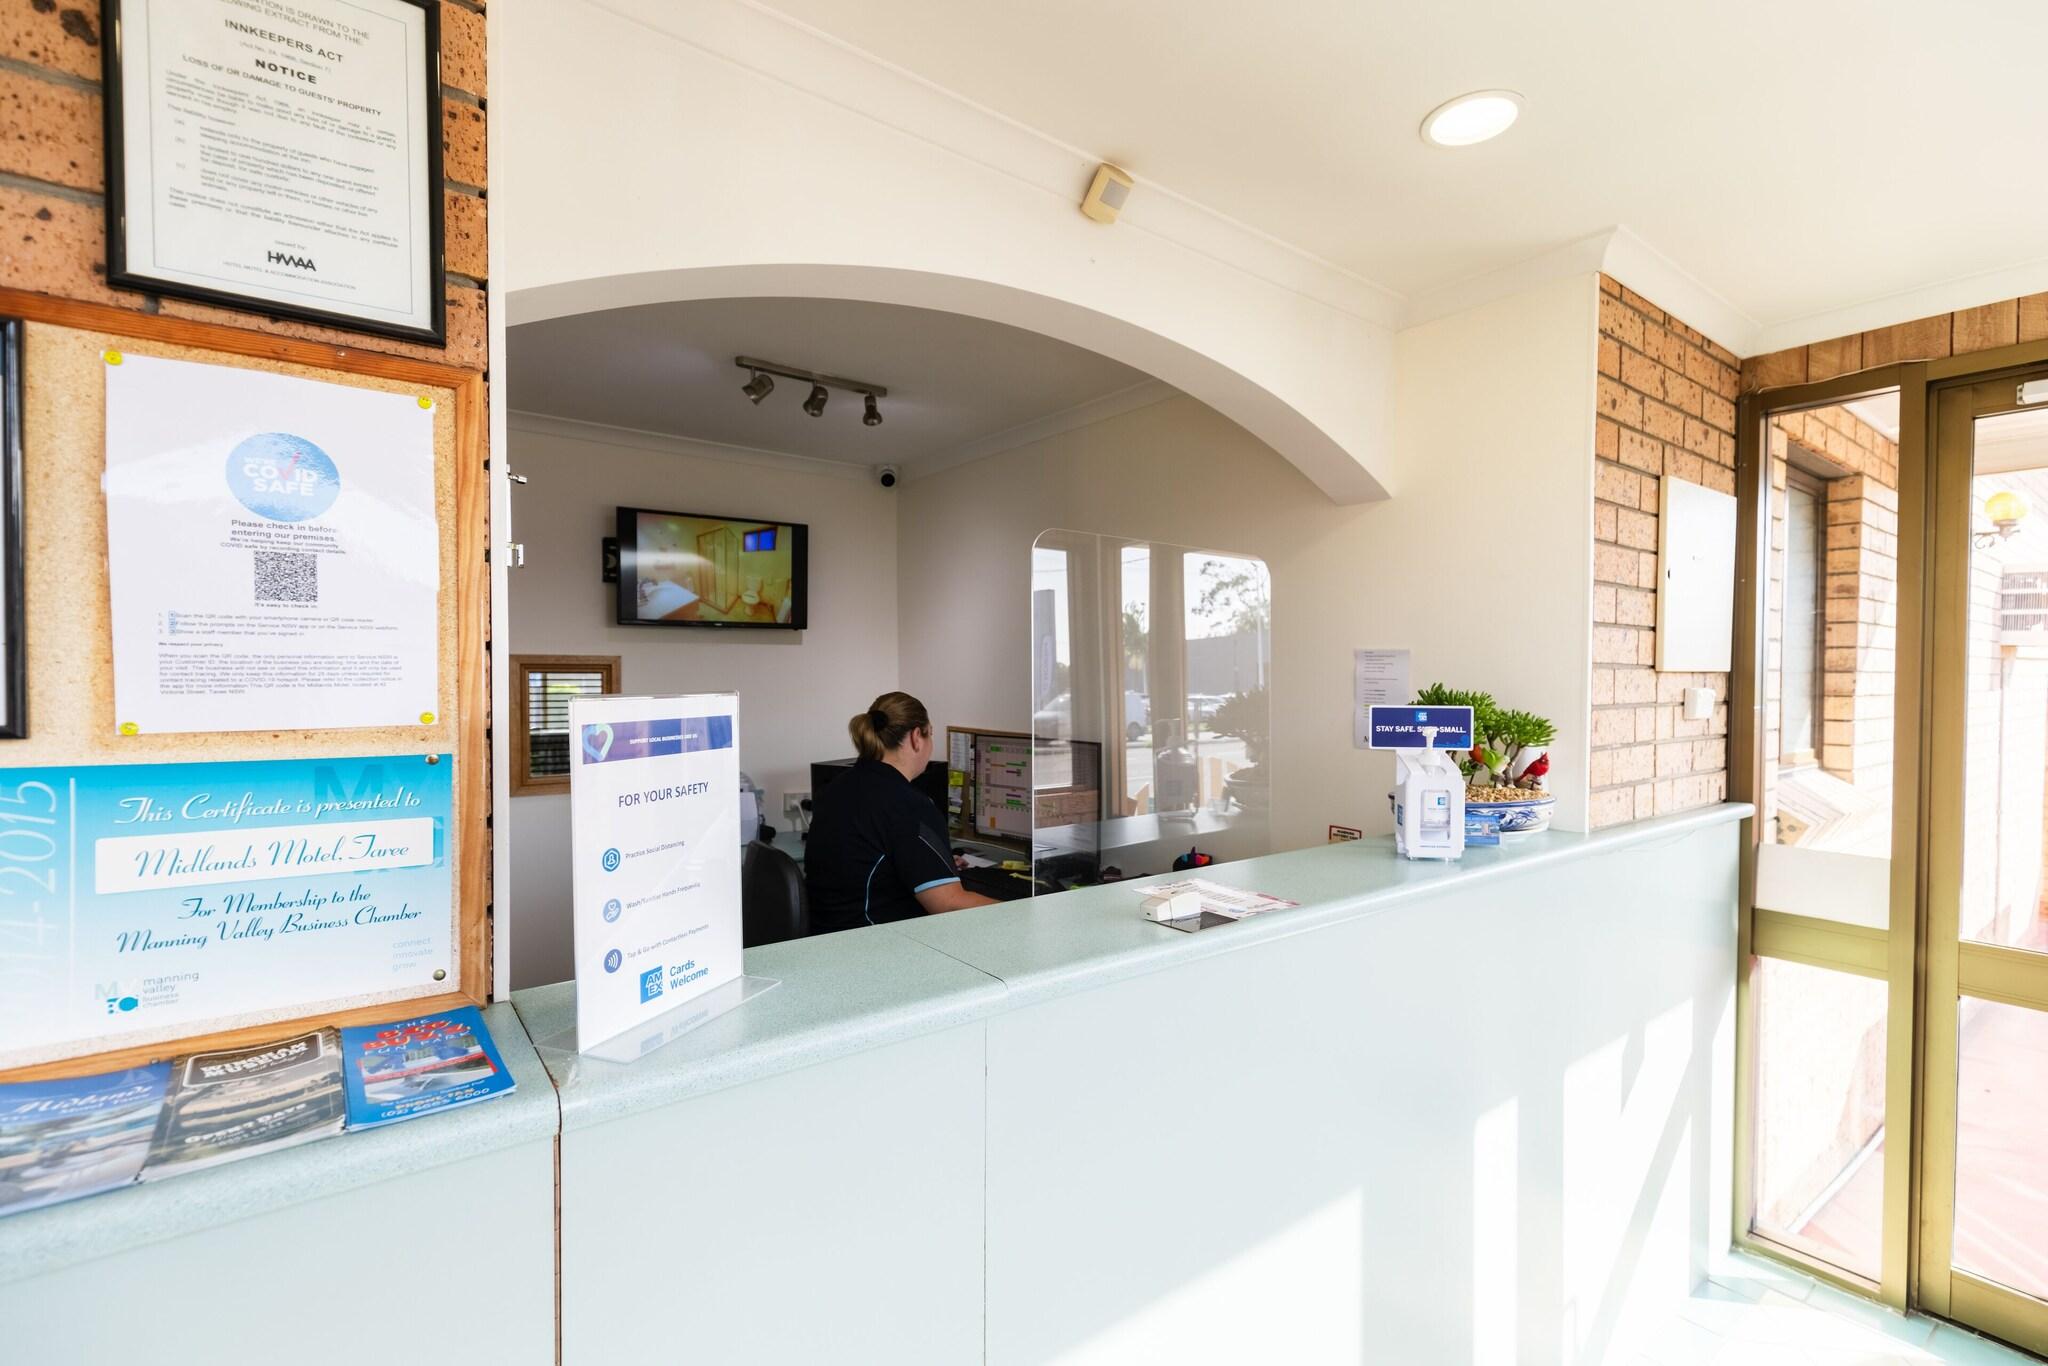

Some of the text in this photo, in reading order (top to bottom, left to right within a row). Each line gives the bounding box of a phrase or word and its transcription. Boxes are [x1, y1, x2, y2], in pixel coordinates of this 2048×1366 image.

[265, 7, 309, 28] EXTRACT
[312, 23, 340, 39] FROM
[297, 10, 334, 28] DRAWN
[336, 22, 349, 33] TO
[352, 26, 370, 40] THE
[224, 18, 313, 53] INNKEEPERS
[317, 48, 343, 63] ACT
[255, 58, 317, 85] NOTICE
[182, 53, 209, 68] LOSS
[210, 63, 223, 72] OF
[226, 67, 240, 77] OR
[242, 71, 281, 89] DAMAGE
[284, 84, 297, 93] TO
[337, 99, 382, 117] PROPERTY
[253, 478, 315, 498] SAFE
[231, 519, 264, 528] Please
[266, 520, 295, 531] check
[297, 522, 306, 531] in
[231, 529, 272, 540] entering
[274, 531, 291, 539] our
[1375, 725, 1394, 733] STAY
[1395, 725, 1415, 733] SAFE.
[1439, 726, 1467, 734] SMALL.
[114, 786, 421, 825] This Certificate is presented to
[618, 781, 710, 808] FOR YOUR SAFETY
[135, 844, 257, 877] Midlands
[348, 834, 409, 860] Taree
[646, 845, 660, 855] Social
[177, 884, 371, 919] For Membership to the
[116, 903, 422, 953] Manning Valley Business Chamber
[392, 937, 432, 950] connect
[143, 972, 200, 987] manning
[646, 972, 663, 987] AM
[669, 960, 695, 977] Cards
[669, 967, 709, 991] Welcome
[143, 983, 176, 994] valley
[648, 984, 663, 997] EX
